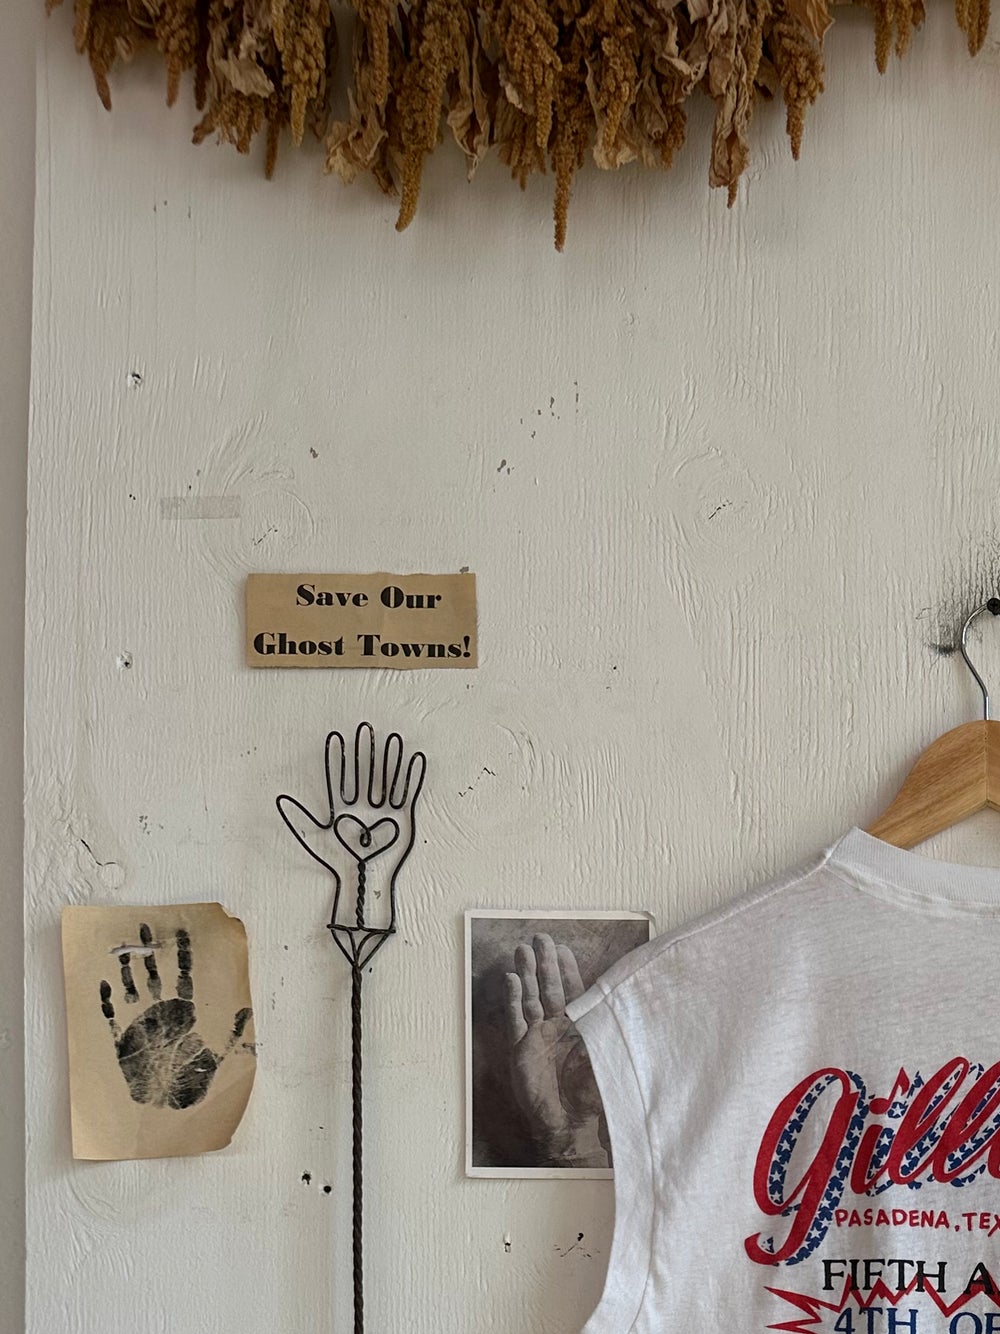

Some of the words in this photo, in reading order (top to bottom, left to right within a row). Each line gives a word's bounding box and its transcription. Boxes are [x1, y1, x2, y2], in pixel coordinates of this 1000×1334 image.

[296, 583, 369, 608] Save
[380, 585, 442, 609] Our
[253, 631, 346, 656] Ghost
[357, 634, 471, 658] Towns!
[834, 1209, 961, 1233] PASADENA,
[822, 1258, 947, 1293] FIFTH
